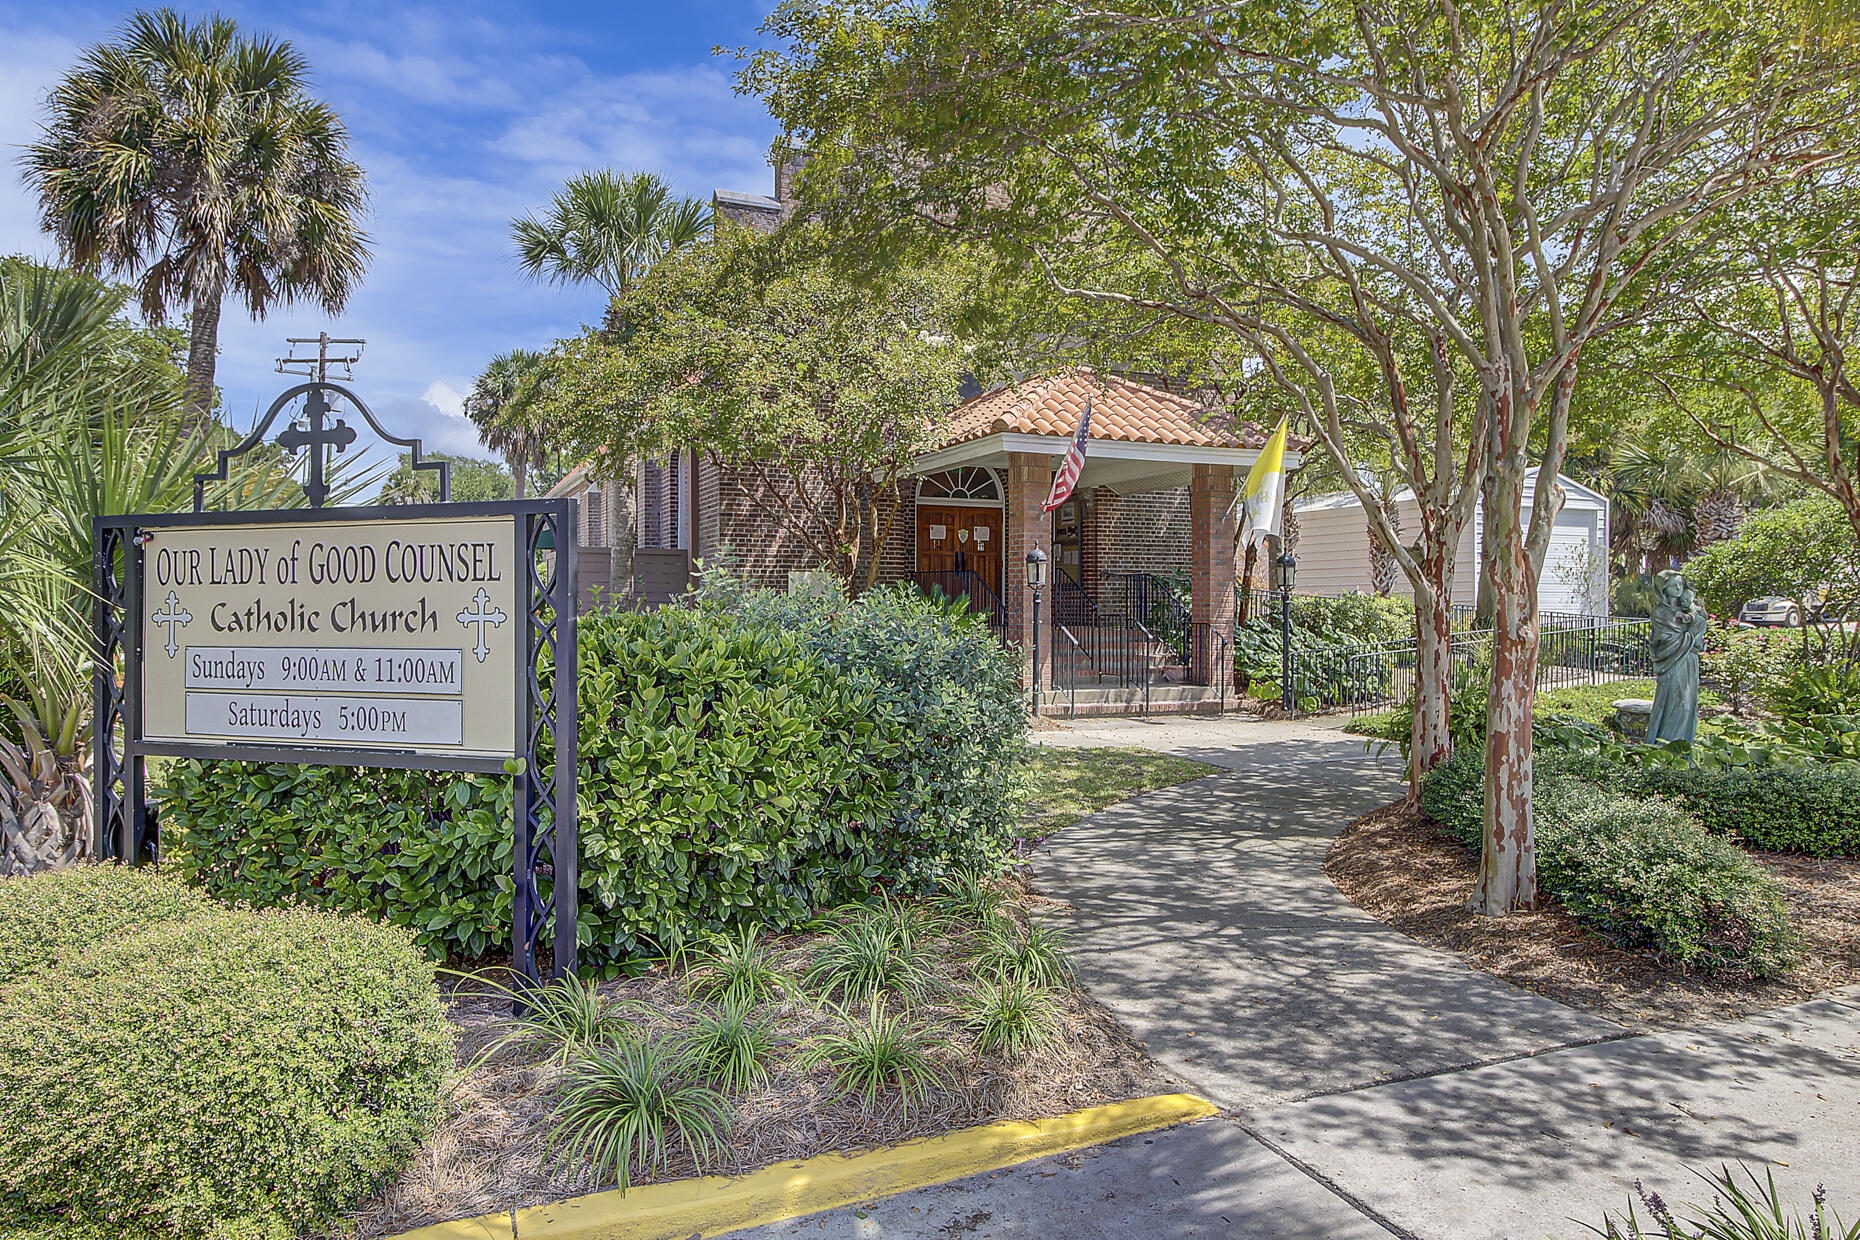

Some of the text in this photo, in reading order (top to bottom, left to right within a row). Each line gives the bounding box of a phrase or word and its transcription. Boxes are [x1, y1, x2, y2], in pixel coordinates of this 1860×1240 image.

[157, 540, 502, 587] OUR LADY of GOOD COUNSEL
[210, 597, 439, 634] Catholic Church
[192, 651, 455, 687] Sundays 9:00AM & 11:00AM
[228, 699, 407, 737] Saturdays 5:00PM
